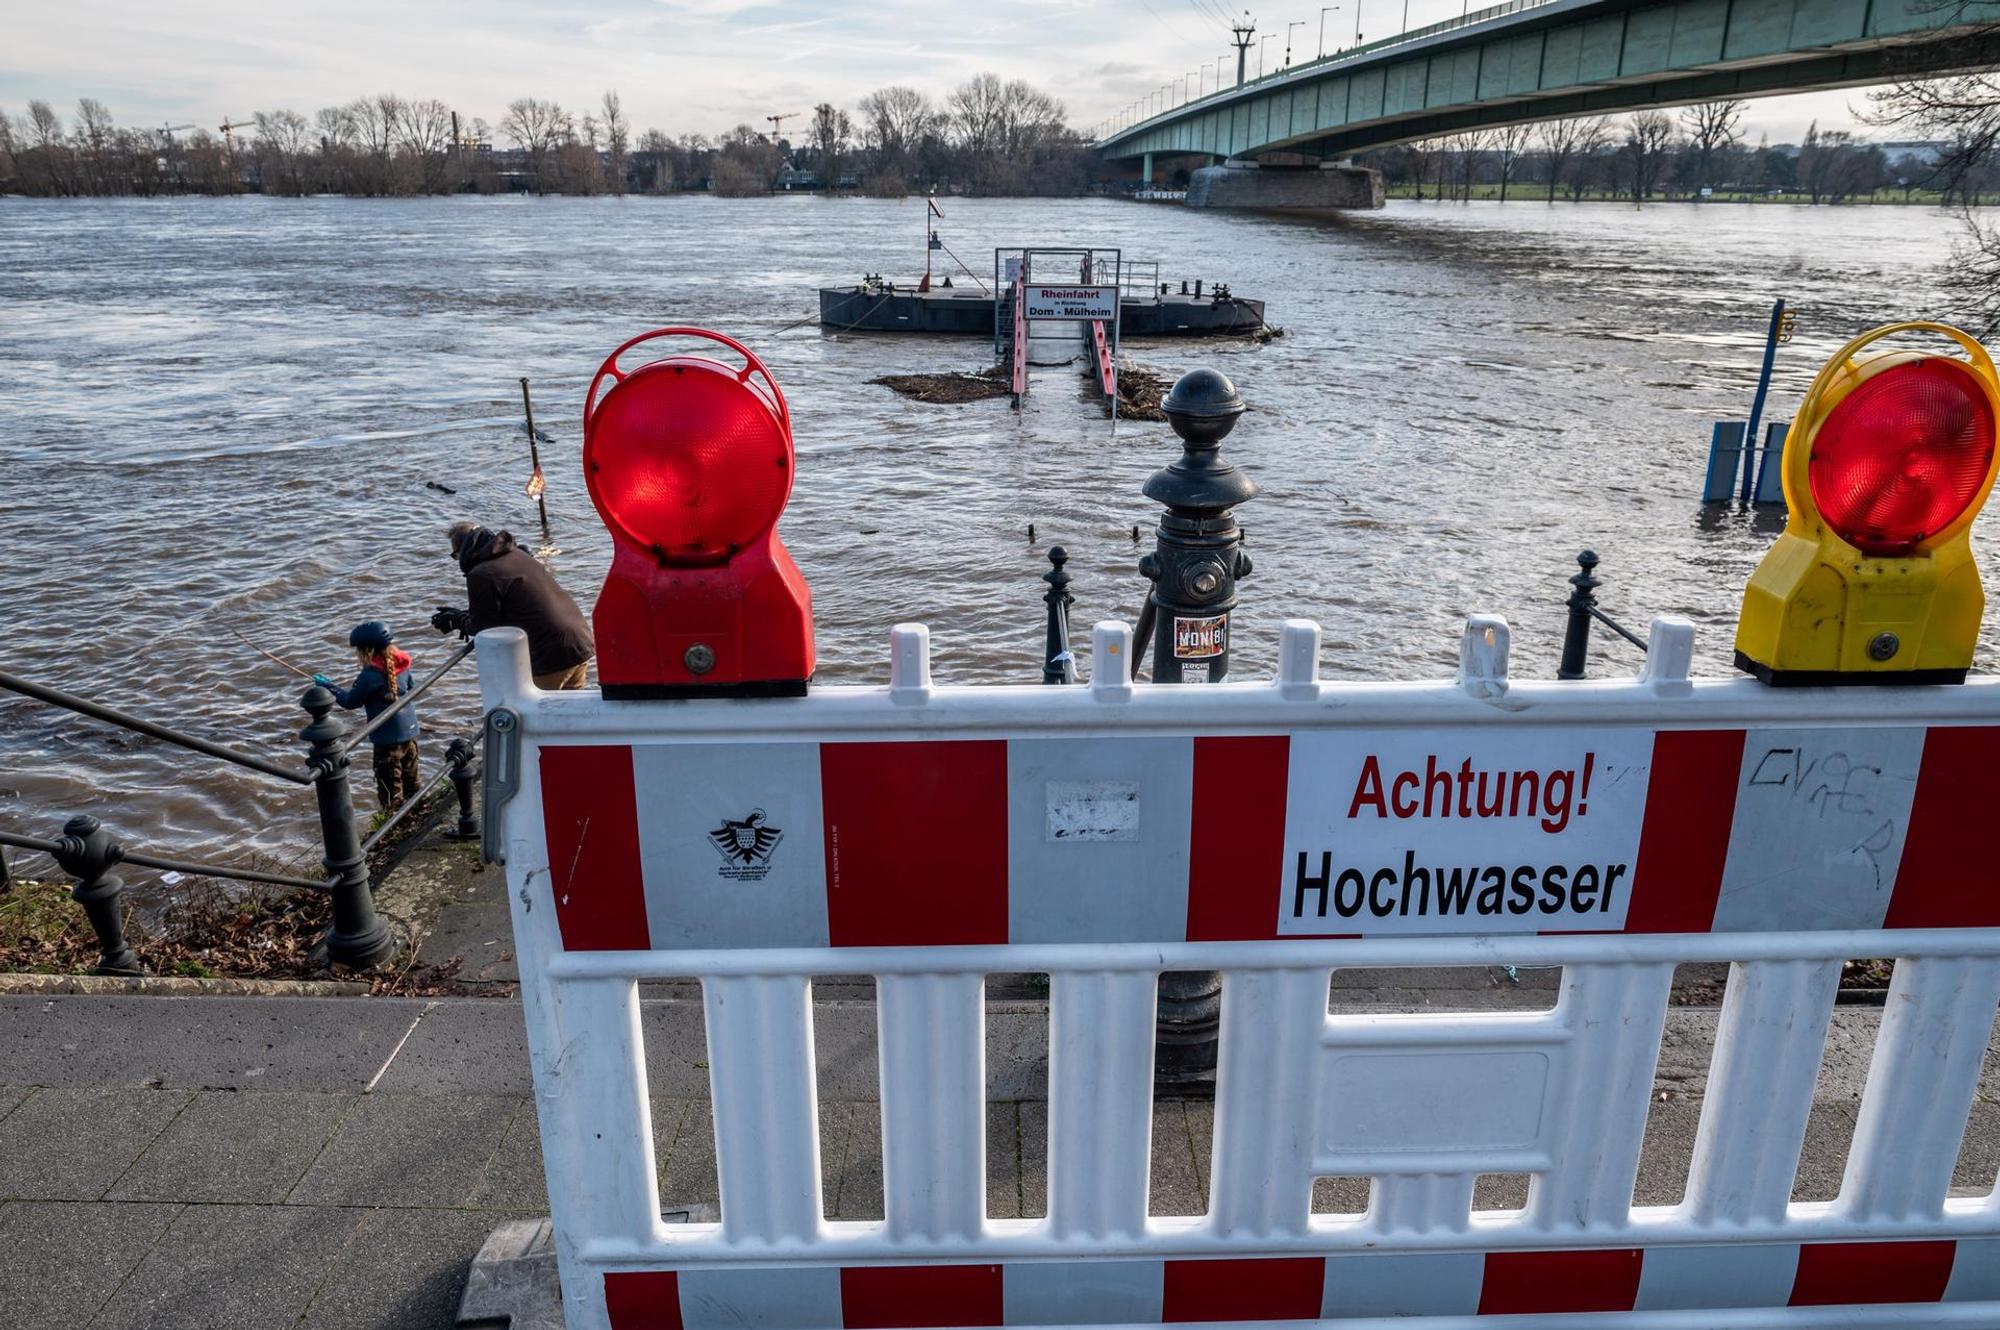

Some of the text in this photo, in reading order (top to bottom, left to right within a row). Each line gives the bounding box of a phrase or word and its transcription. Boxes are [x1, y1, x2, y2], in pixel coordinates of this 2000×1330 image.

[1029, 307, 1054, 316] Dom
[1064, 307, 1111, 316] Mülheim
[1041, 290, 1100, 299] Rheinfahrt
[1348, 752, 1595, 833] Achtung!
[1293, 850, 1627, 918] Hochwasser
